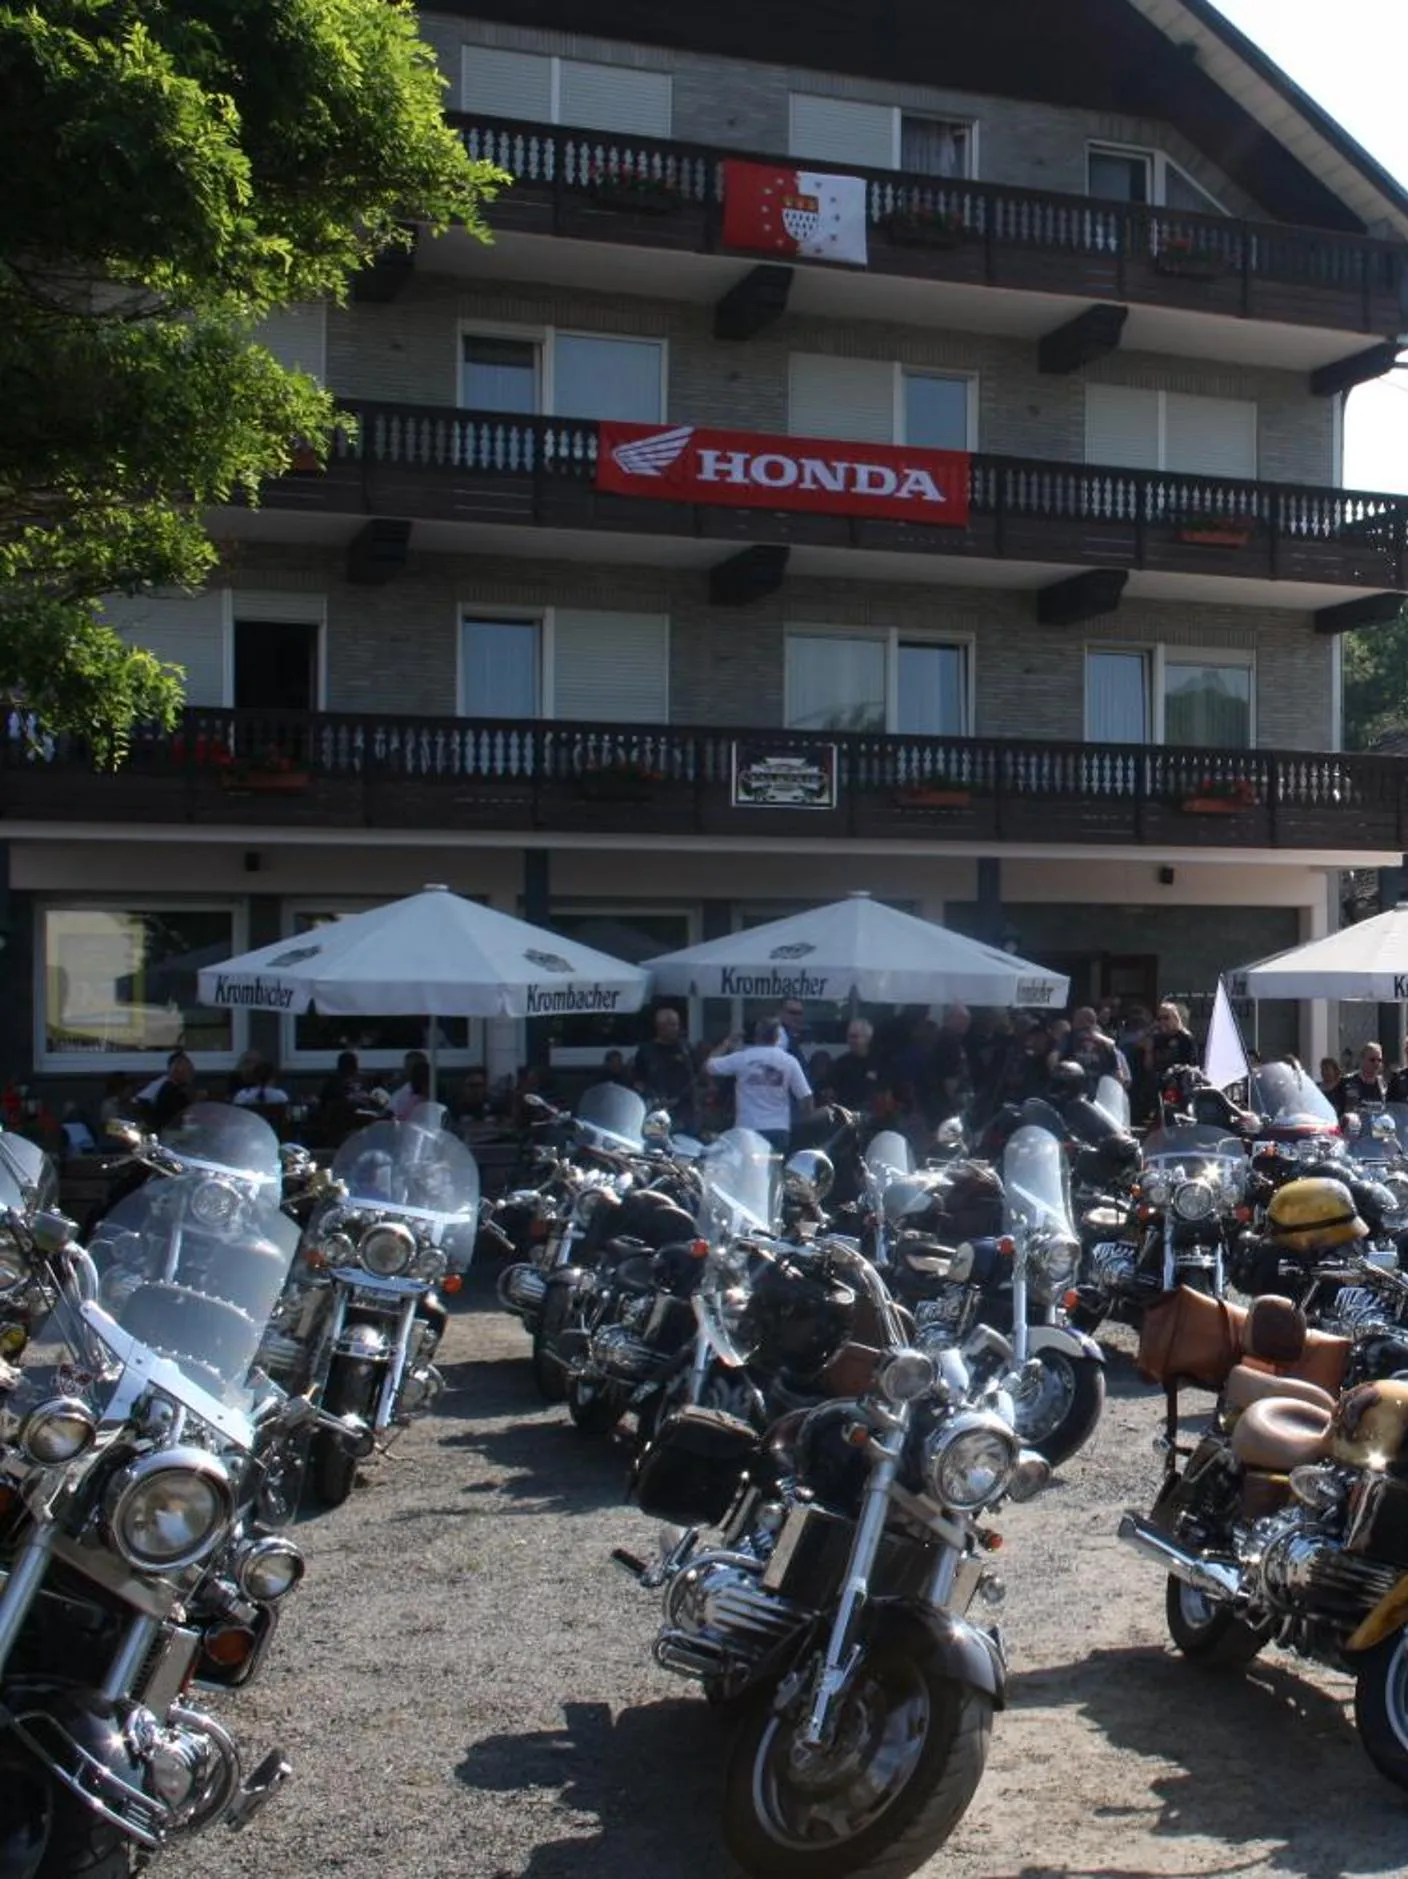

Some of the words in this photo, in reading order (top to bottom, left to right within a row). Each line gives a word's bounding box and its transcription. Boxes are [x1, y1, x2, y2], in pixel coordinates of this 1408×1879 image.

[697, 449, 946, 502] HONDA
[722, 968, 828, 996] Krombacher
[527, 983, 620, 1013] Krombacher
